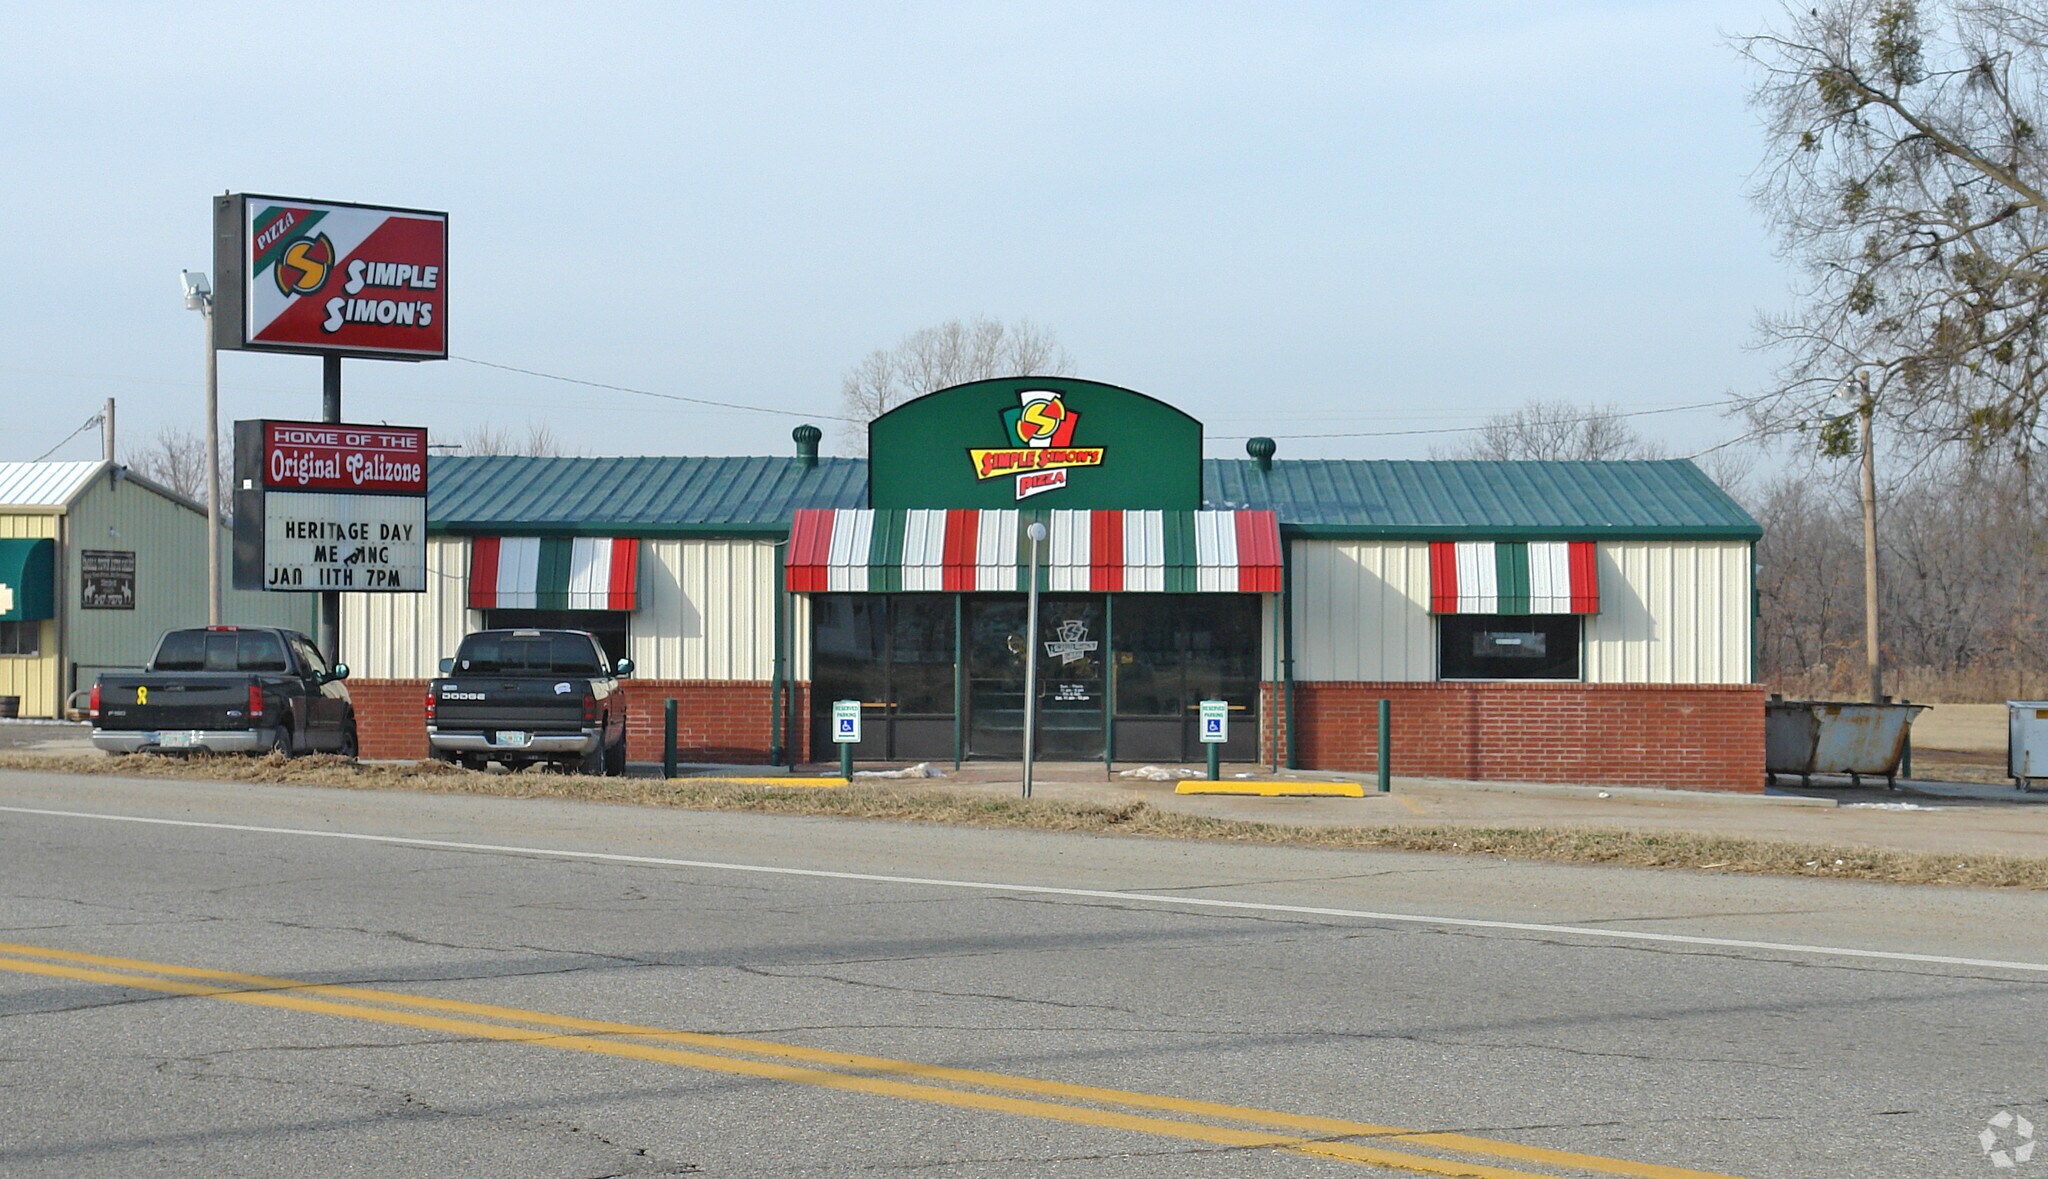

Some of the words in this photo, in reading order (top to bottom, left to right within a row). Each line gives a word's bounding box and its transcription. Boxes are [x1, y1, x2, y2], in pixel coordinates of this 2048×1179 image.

[256, 211, 295, 250] PIZZA
[344, 259, 439, 295] SIMPLE
[322, 296, 433, 333] SIMON'S
[274, 431, 338, 445] HOME
[345, 434, 372, 446] OF
[378, 435, 418, 449] THE
[271, 449, 341, 485] Original
[345, 452, 421, 485] Calizone
[981, 451, 1035, 476] SIMPLE
[1037, 448, 1099, 468] SIMON'S
[1019, 471, 1065, 496] PIZZA
[285, 521, 369, 541] HERITAGE
[380, 523, 413, 541] DAY
[319, 568, 353, 586] 11TH
[366, 569, 401, 587] 7PM
